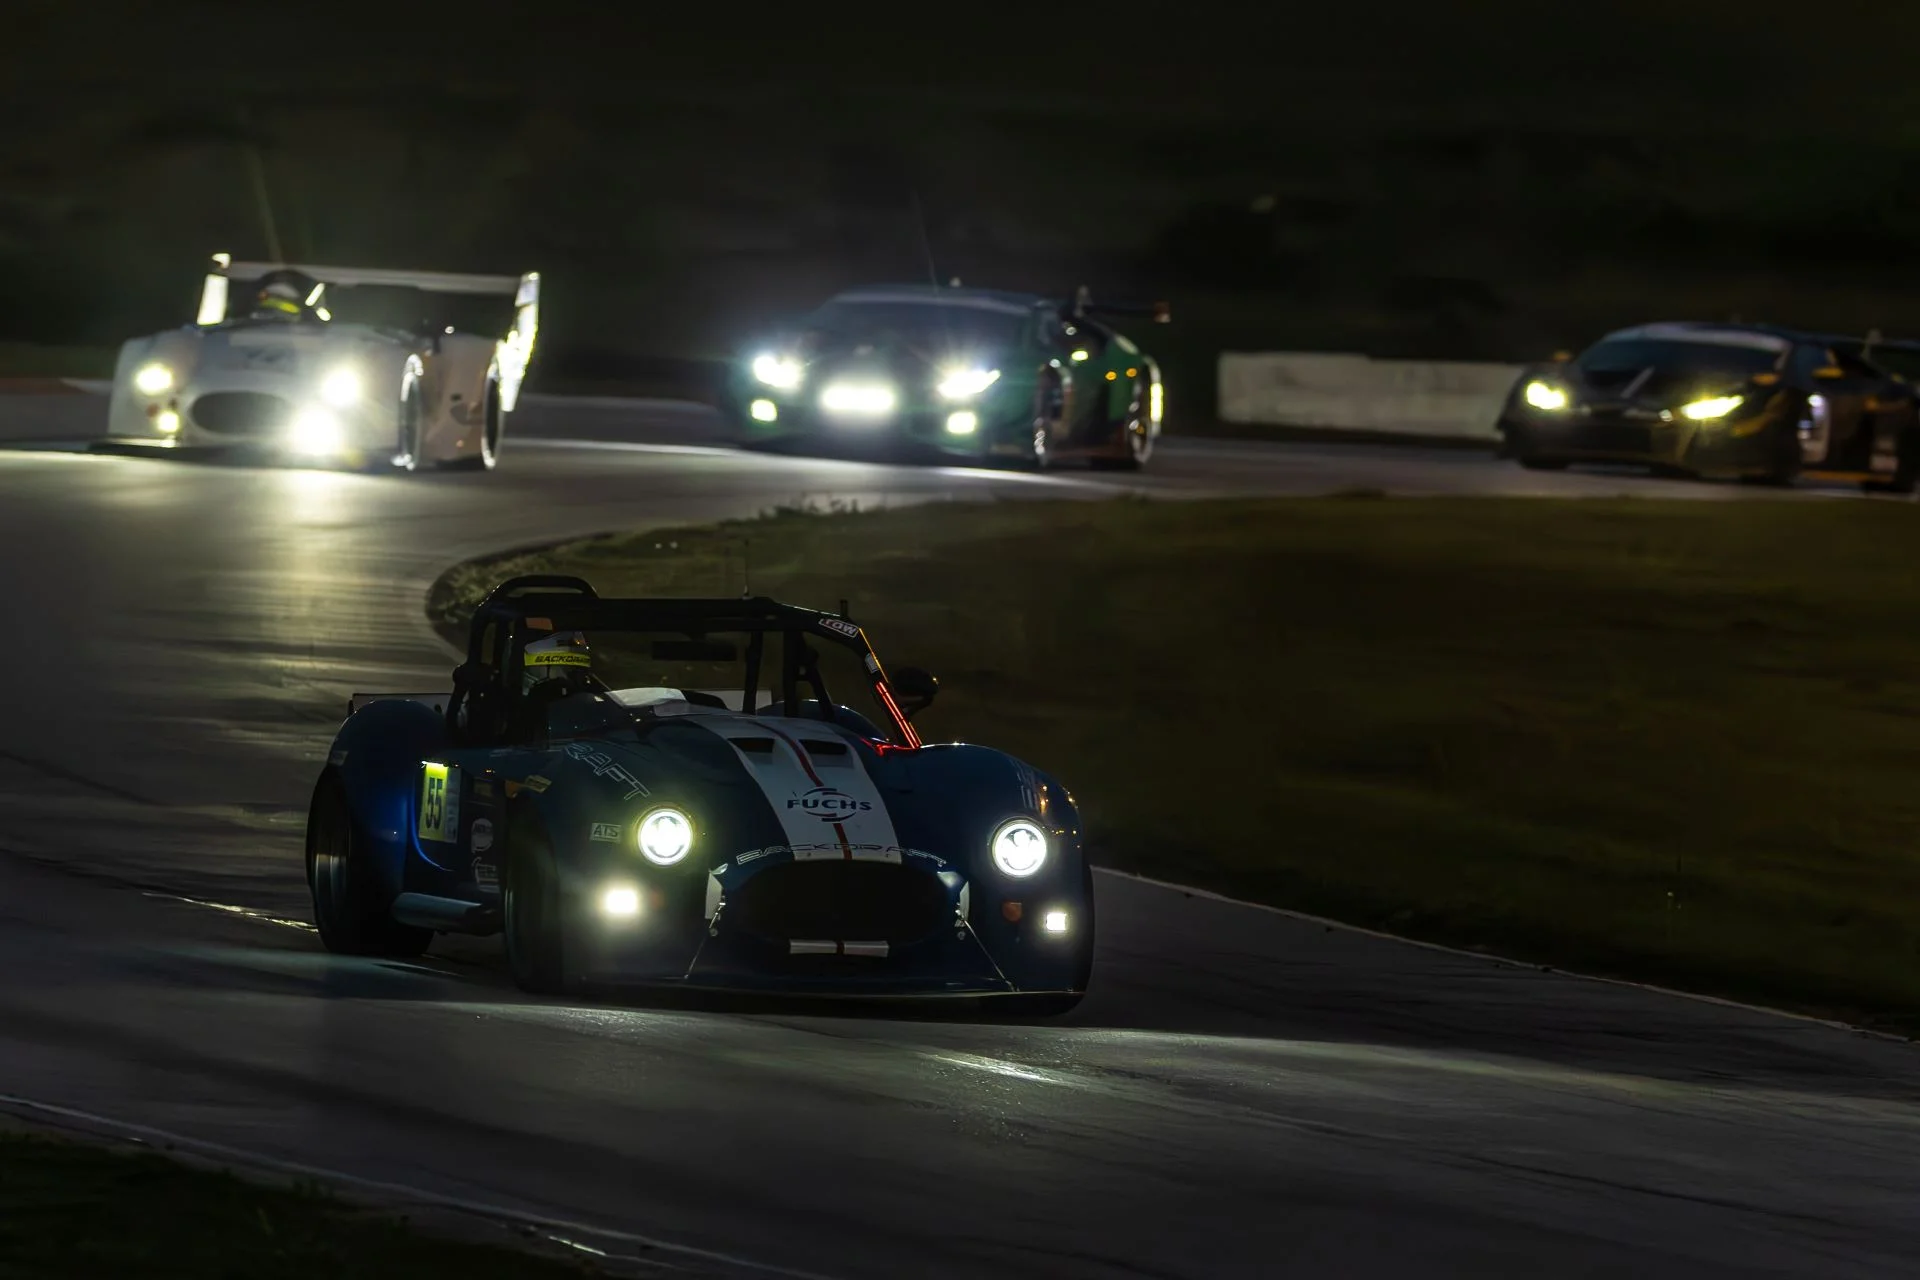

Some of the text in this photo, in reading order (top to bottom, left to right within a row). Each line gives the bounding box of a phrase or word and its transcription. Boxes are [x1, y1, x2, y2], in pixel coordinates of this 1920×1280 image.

[426, 777, 443, 829] 55
[787, 799, 872, 810] FUCHS
[594, 824, 618, 838] ATS
